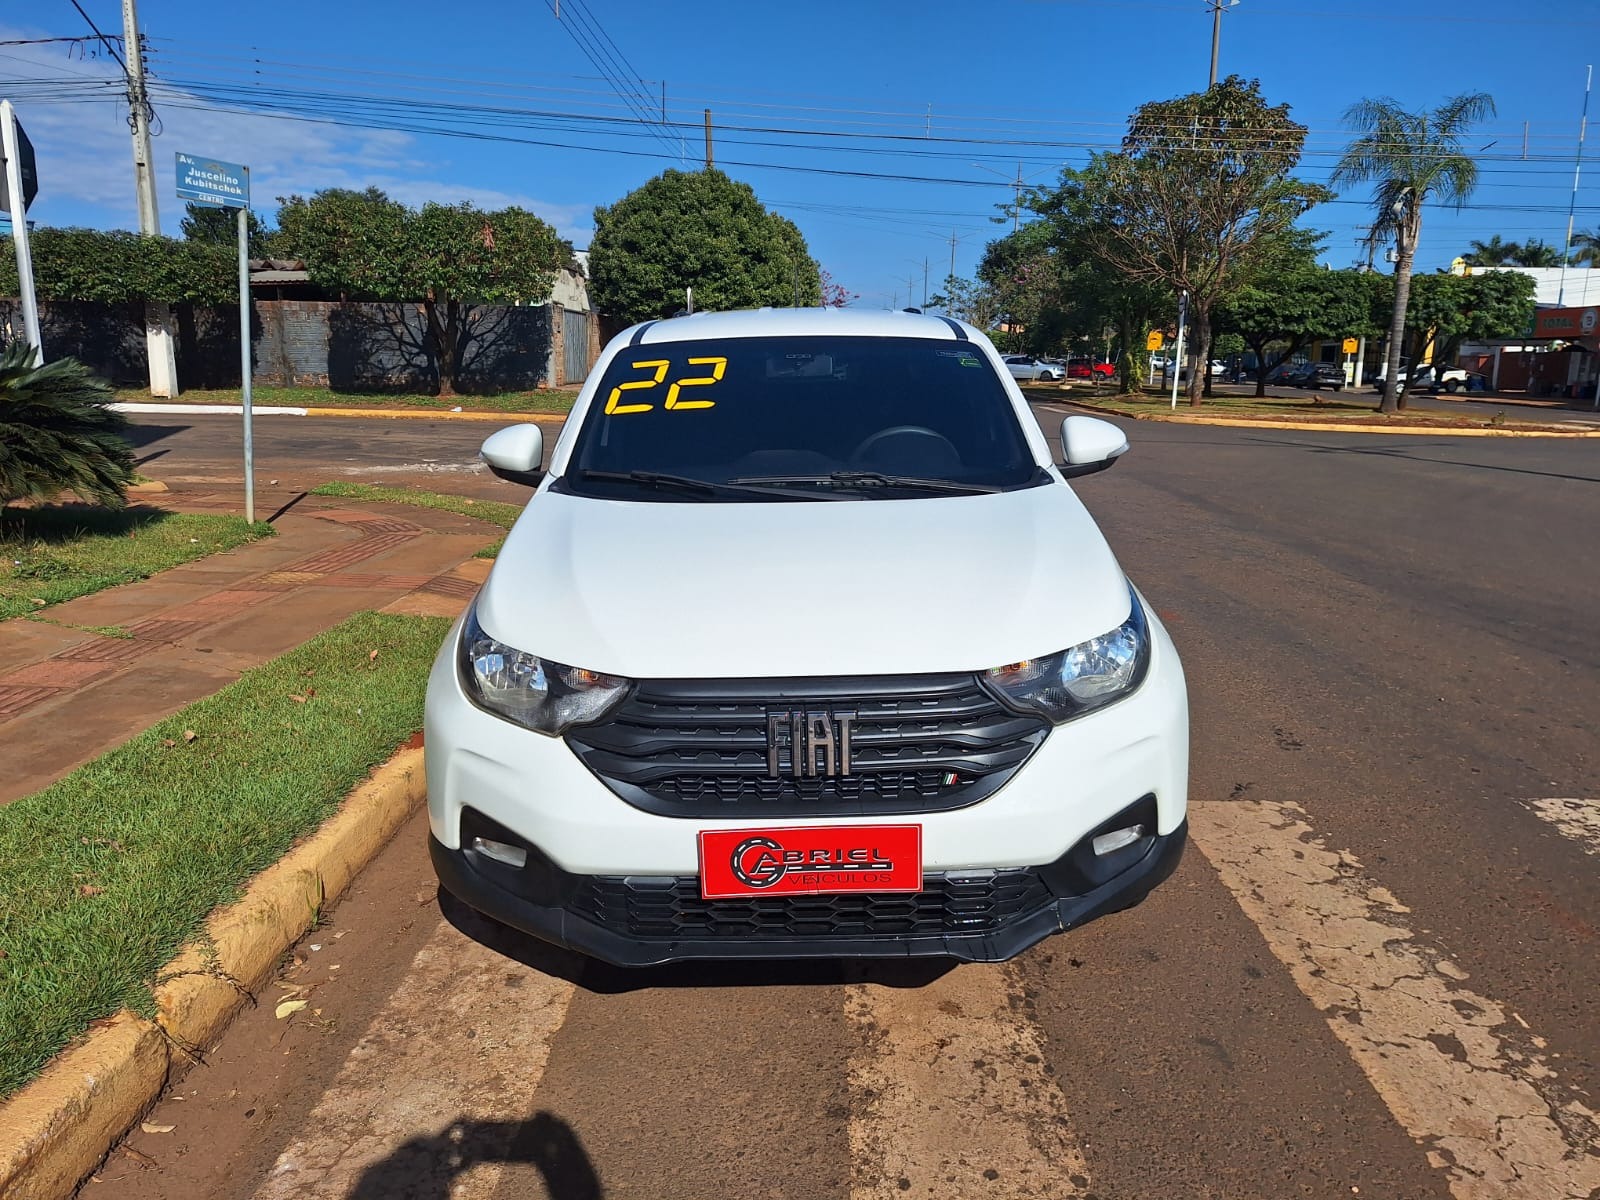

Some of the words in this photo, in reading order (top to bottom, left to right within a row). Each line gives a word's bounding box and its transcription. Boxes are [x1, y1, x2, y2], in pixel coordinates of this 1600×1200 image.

[180, 155, 194, 165] Av.
[188, 168, 239, 185] Juscelino
[185, 177, 242, 195] Kubitschek
[199, 194, 225, 204] CENTRO
[604, 357, 728, 415] 22
[768, 711, 857, 777] FIAT
